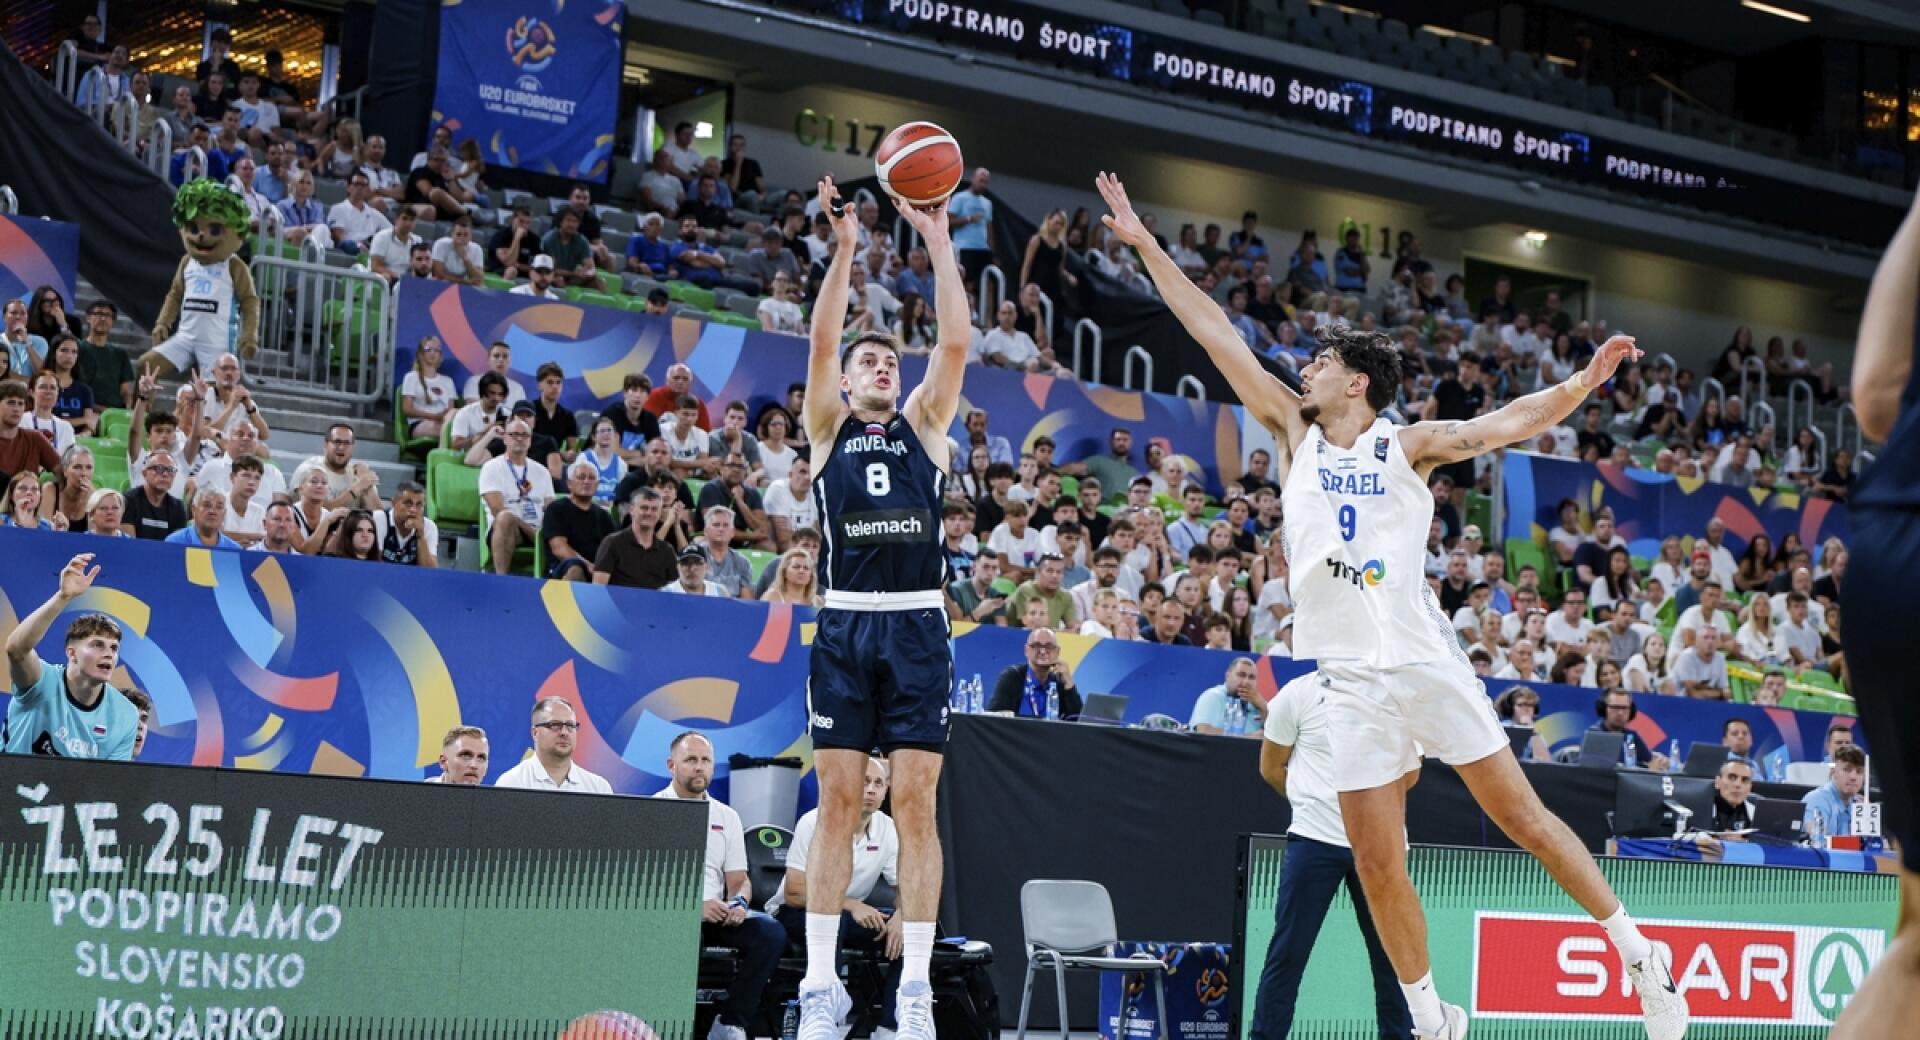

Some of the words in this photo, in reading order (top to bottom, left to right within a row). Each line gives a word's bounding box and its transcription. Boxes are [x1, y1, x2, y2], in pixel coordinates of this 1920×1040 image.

[889, 0, 1024, 42] PODPIRAMO
[1039, 22, 1111, 60] ŠPORT
[479, 83, 502, 101] U20
[504, 88, 576, 115] EUROBASKET
[1153, 51, 1275, 97] PODPIRAMO
[1288, 79, 1353, 115] ŠPORT
[1391, 106, 1502, 149] PODPIRAMO
[1514, 130, 1572, 164] ŠPORT
[866, 462, 891, 497] 8
[844, 516, 922, 537] telemach
[1338, 504, 1357, 542] 9
[16, 782, 124, 874] ŽE
[143, 802, 224, 878] 25
[244, 807, 384, 891] LET
[49, 887, 342, 942] PODPIRAMO
[75, 940, 305, 990] SLOVENSKO
[95, 992, 285, 1040] KOŠARKO
[1196, 1021, 1229, 1033] EUROBAS
